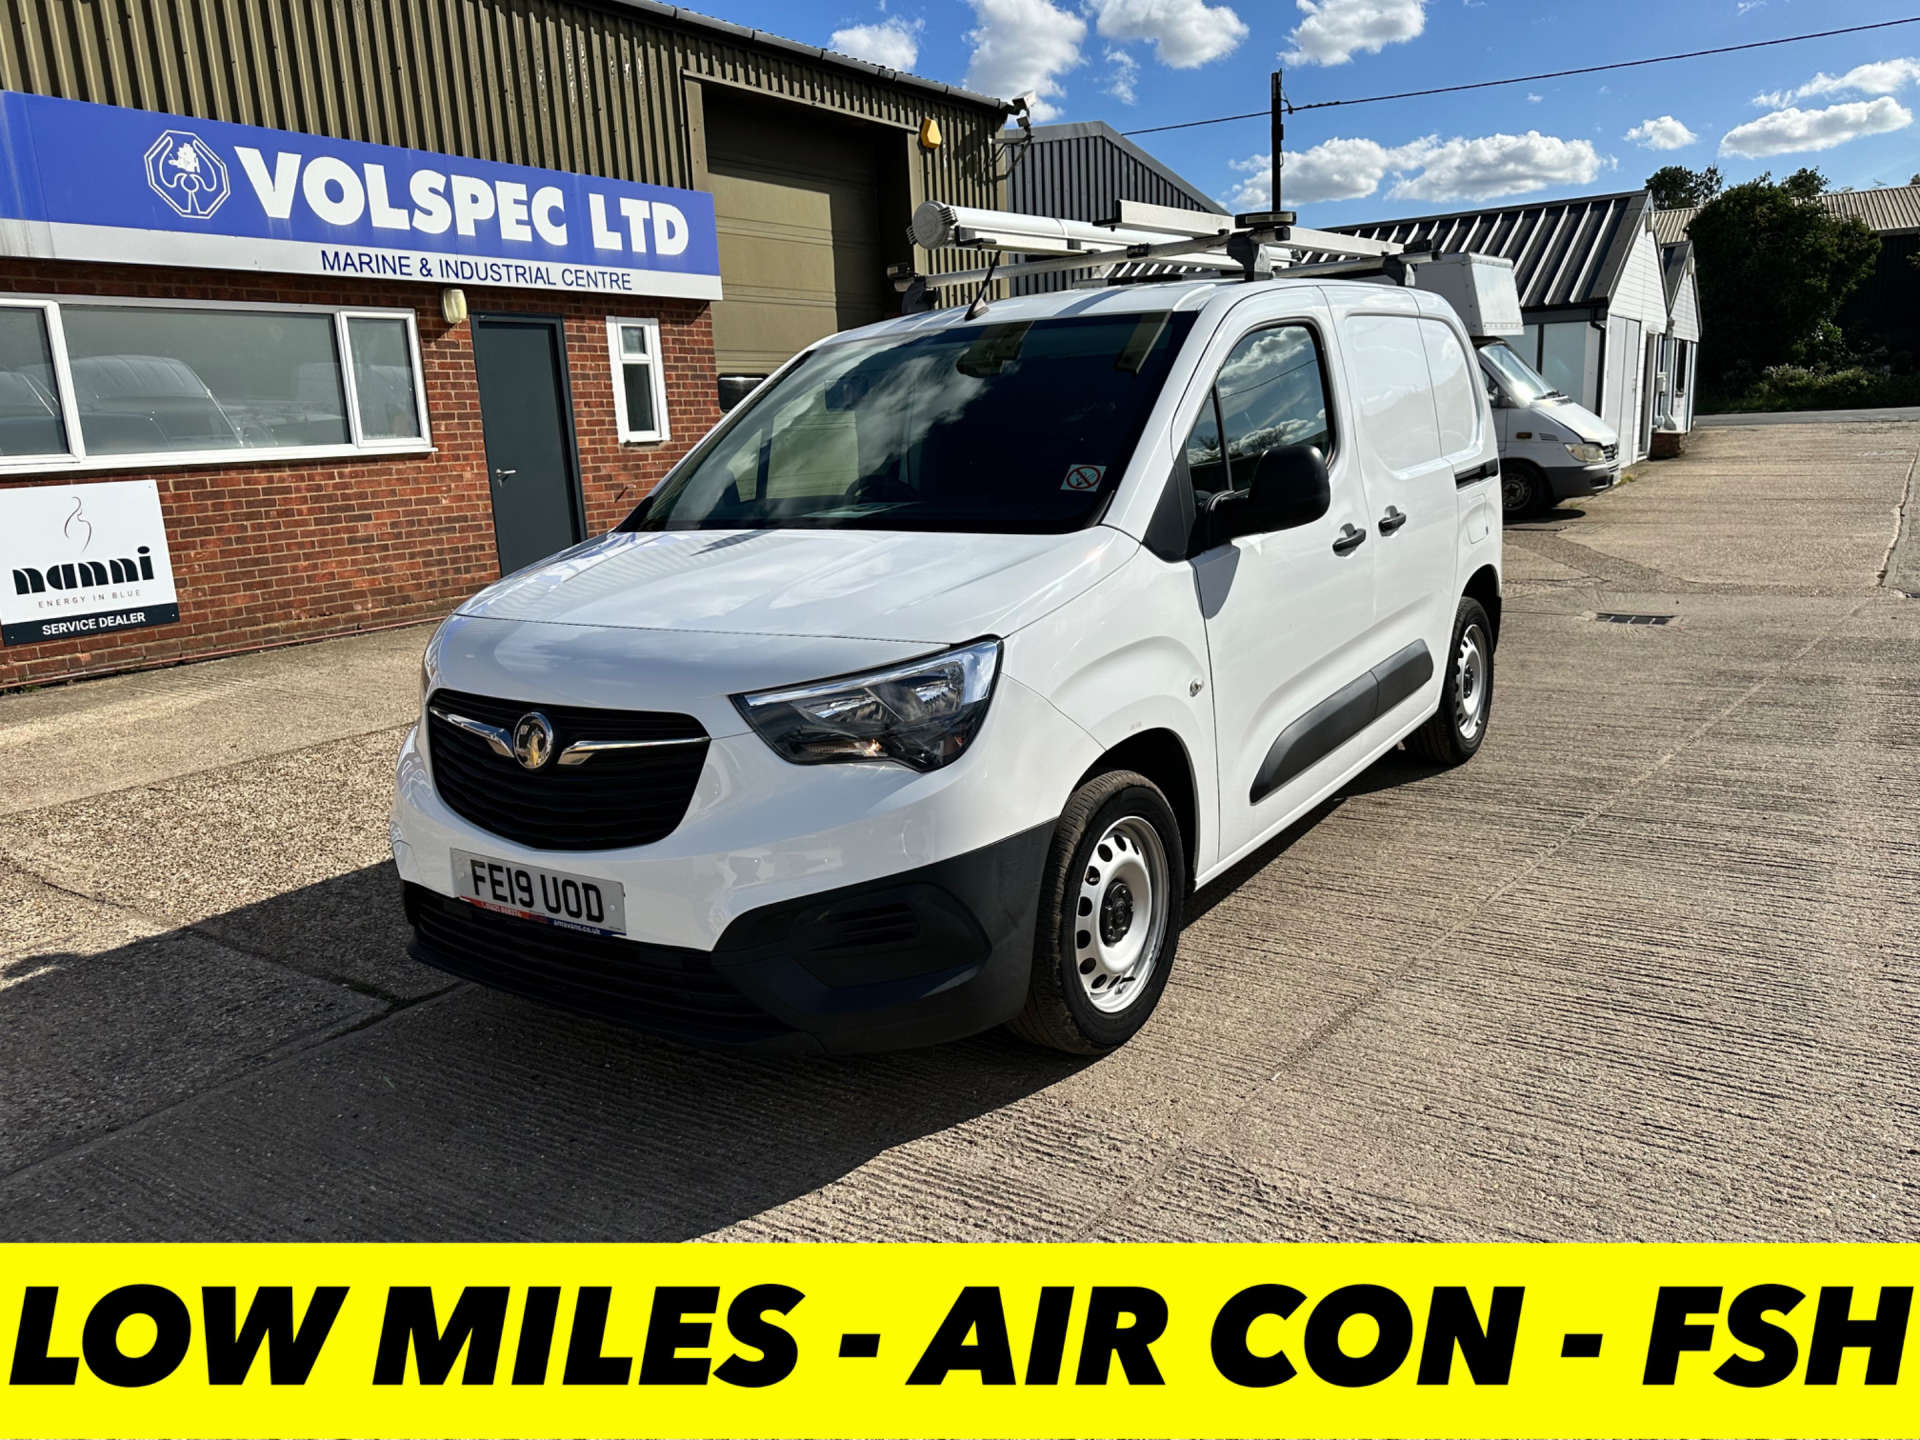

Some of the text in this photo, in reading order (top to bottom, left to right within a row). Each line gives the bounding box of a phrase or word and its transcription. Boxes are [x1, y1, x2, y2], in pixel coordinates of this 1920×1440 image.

[234, 146, 689, 256] VOLSPEC LTD
[321, 250, 632, 291] MARINE & INDUSTRIAL CENTRE
[12, 545, 154, 595] nanni
[38, 589, 141, 608] ENERGY IN BLUE
[42, 612, 146, 635] SERVICE DEALER
[470, 859, 605, 923] FE19 UOD
